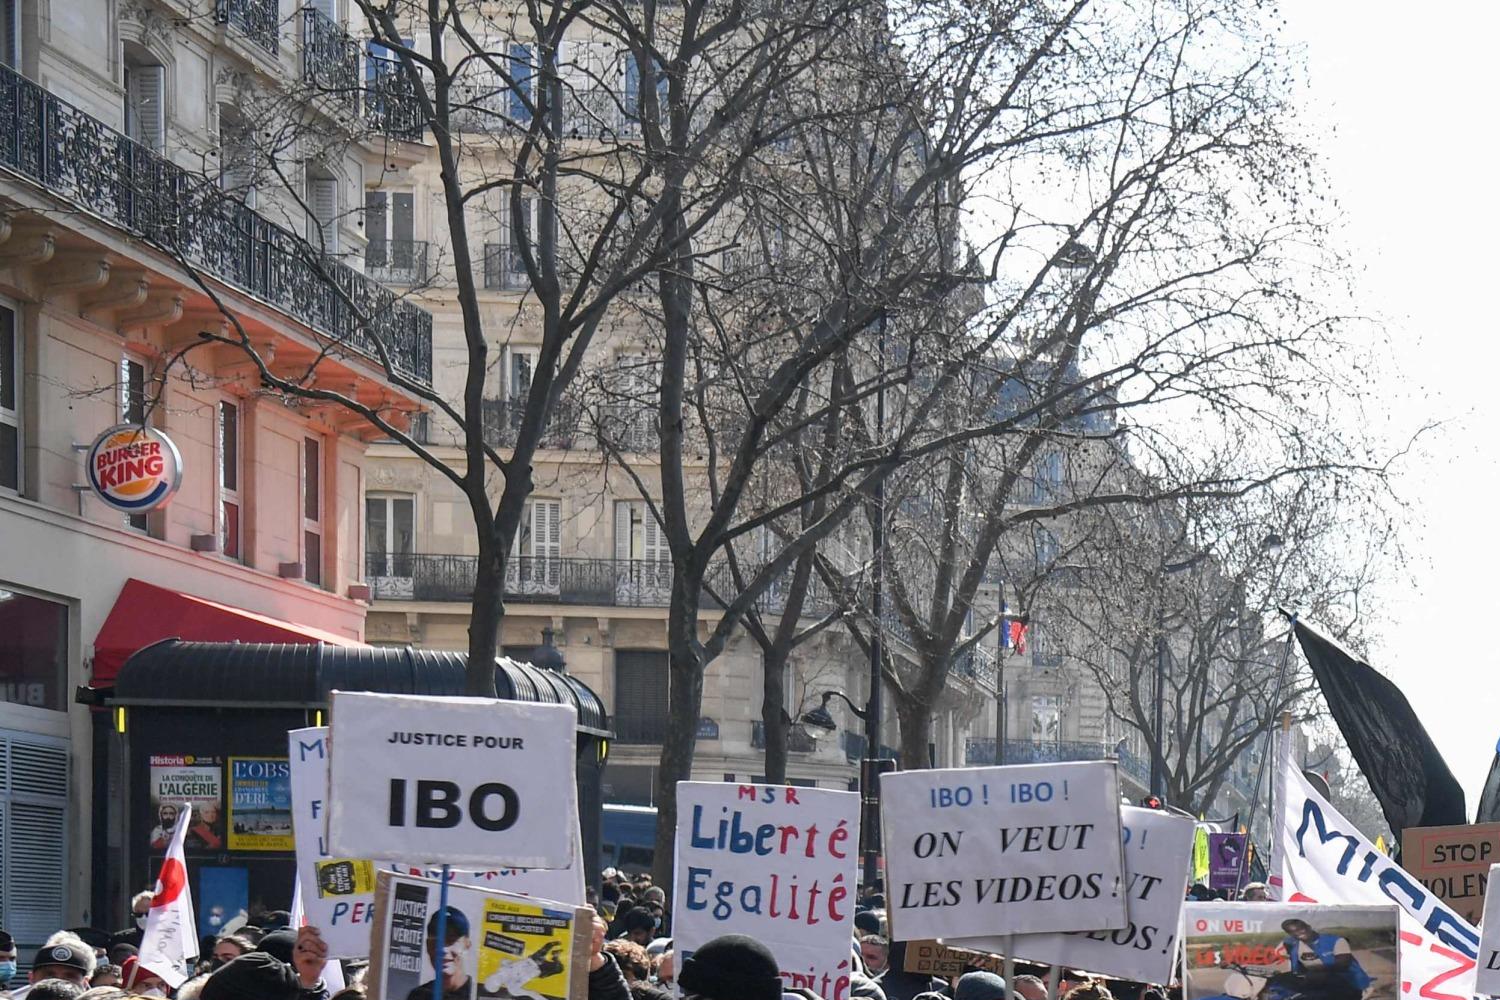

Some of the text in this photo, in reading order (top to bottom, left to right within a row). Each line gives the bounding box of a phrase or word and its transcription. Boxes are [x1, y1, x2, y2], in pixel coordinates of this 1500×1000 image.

[97, 442, 160, 470] BURGER
[100, 456, 163, 491] KING
[388, 731, 524, 750] JUSTICE POUR
[150, 755, 184, 765] Historia
[234, 762, 290, 778] L'OBS
[389, 778, 520, 832] IBO
[931, 786, 973, 808] IBO
[1011, 782, 1053, 803] IBO
[690, 804, 848, 860] Liberté
[914, 831, 963, 859] ON
[1000, 824, 1094, 853] VEUT
[1432, 841, 1492, 863] STOP
[900, 880, 963, 909] LES
[975, 873, 1103, 905] VIDEOS
[393, 899, 427, 918] JUSTICE
[1196, 919, 1263, 933] ON VEUT
